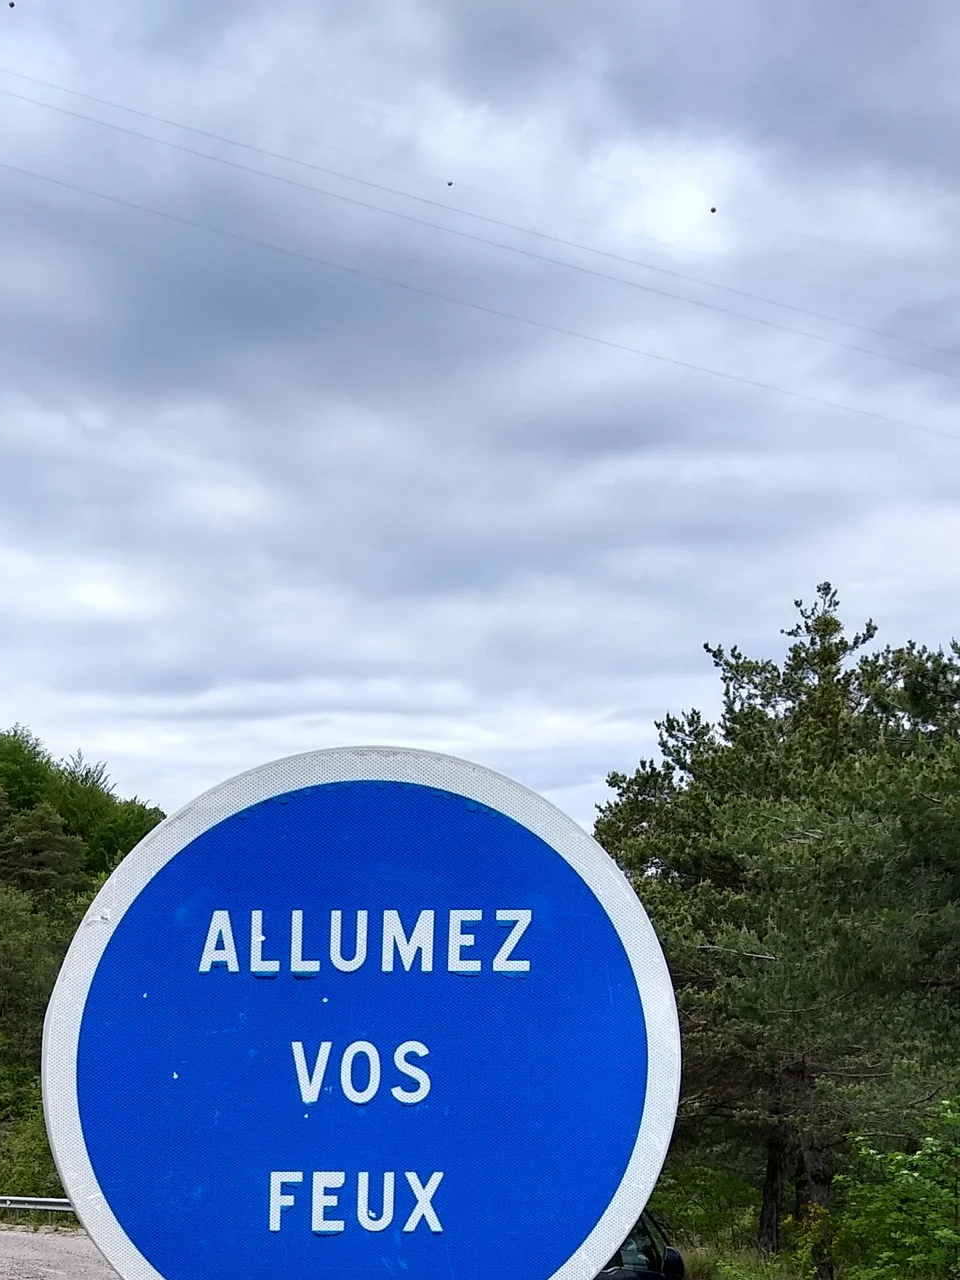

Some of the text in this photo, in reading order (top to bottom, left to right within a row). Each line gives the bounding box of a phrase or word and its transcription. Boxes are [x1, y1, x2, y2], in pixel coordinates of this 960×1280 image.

[199, 910, 532, 972] ALLUMEZ
[292, 1041, 431, 1104] VOS
[270, 1172, 444, 1232] FEUX
